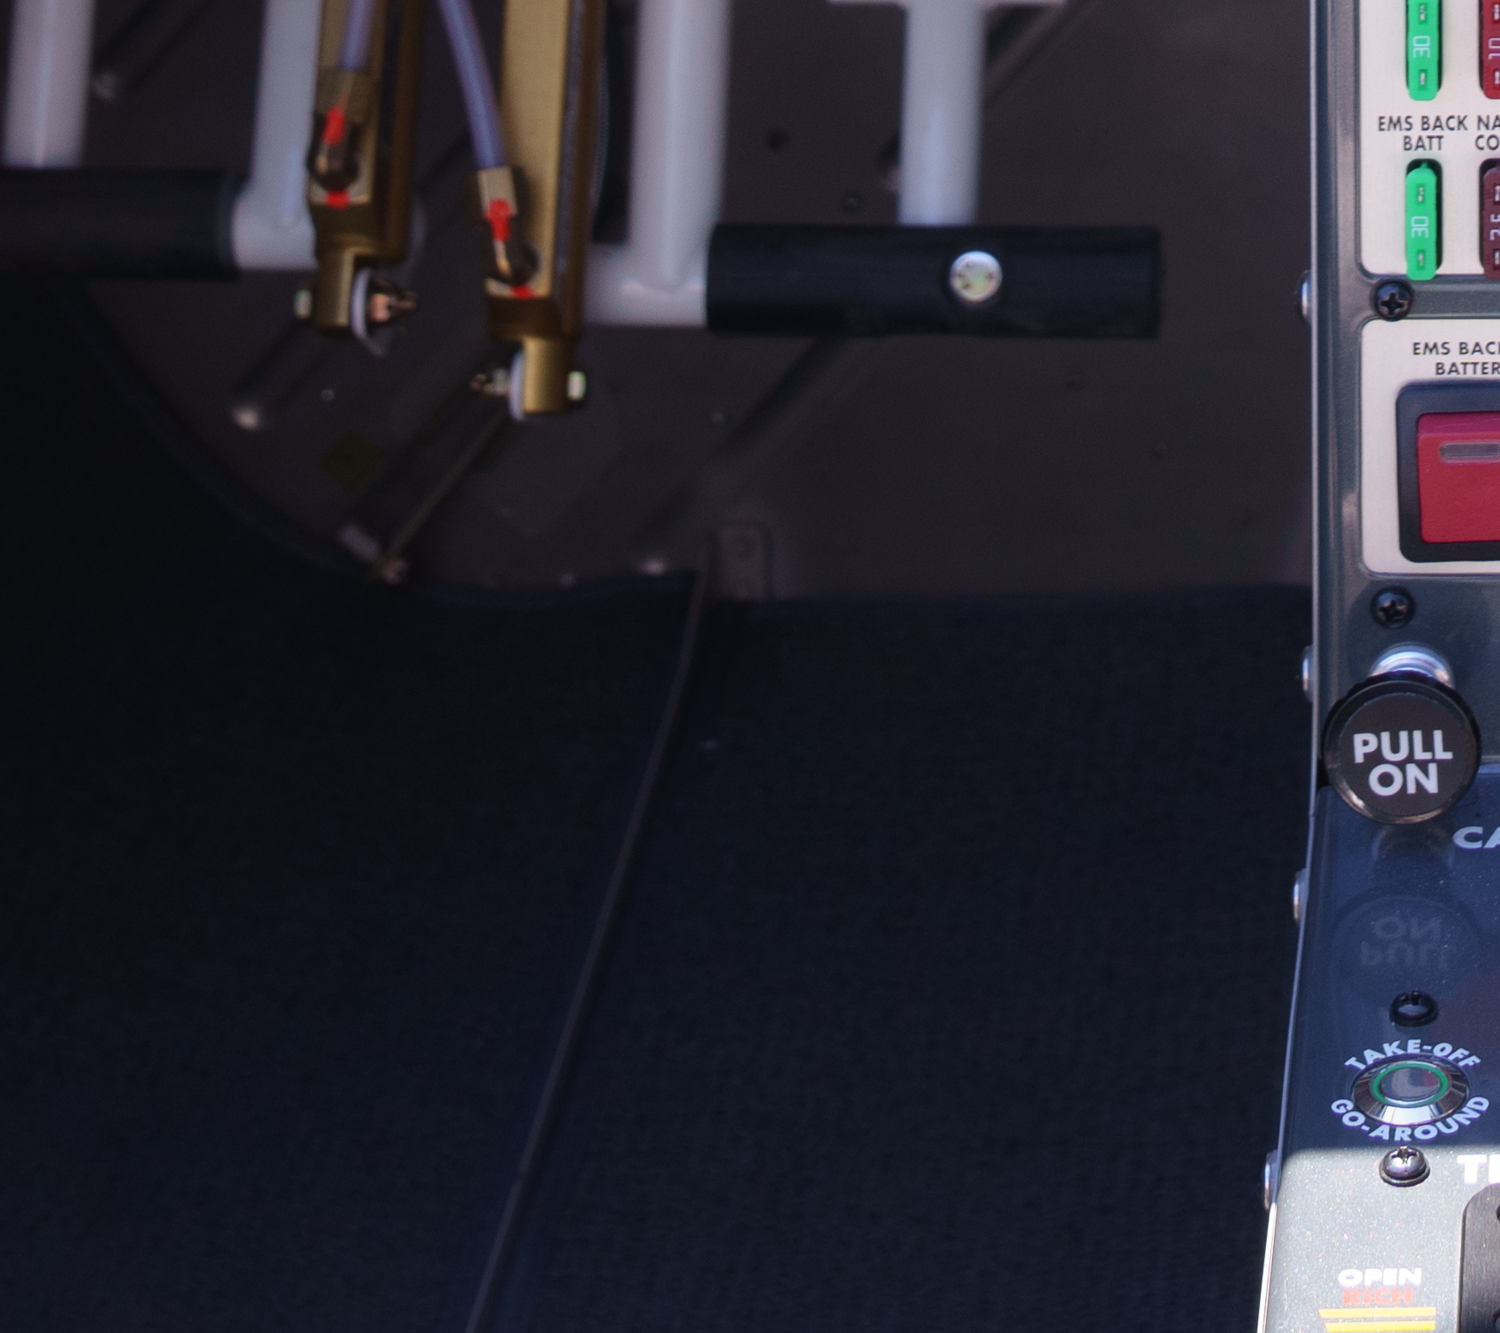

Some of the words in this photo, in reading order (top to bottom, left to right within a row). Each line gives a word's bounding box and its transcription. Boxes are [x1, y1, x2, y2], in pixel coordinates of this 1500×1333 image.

[1412, 343, 1450, 356] EMS
[1354, 730, 1453, 763] PULL
[1369, 763, 1438, 796] ON
[1345, 1040, 1480, 1072] TAKE-OFF
